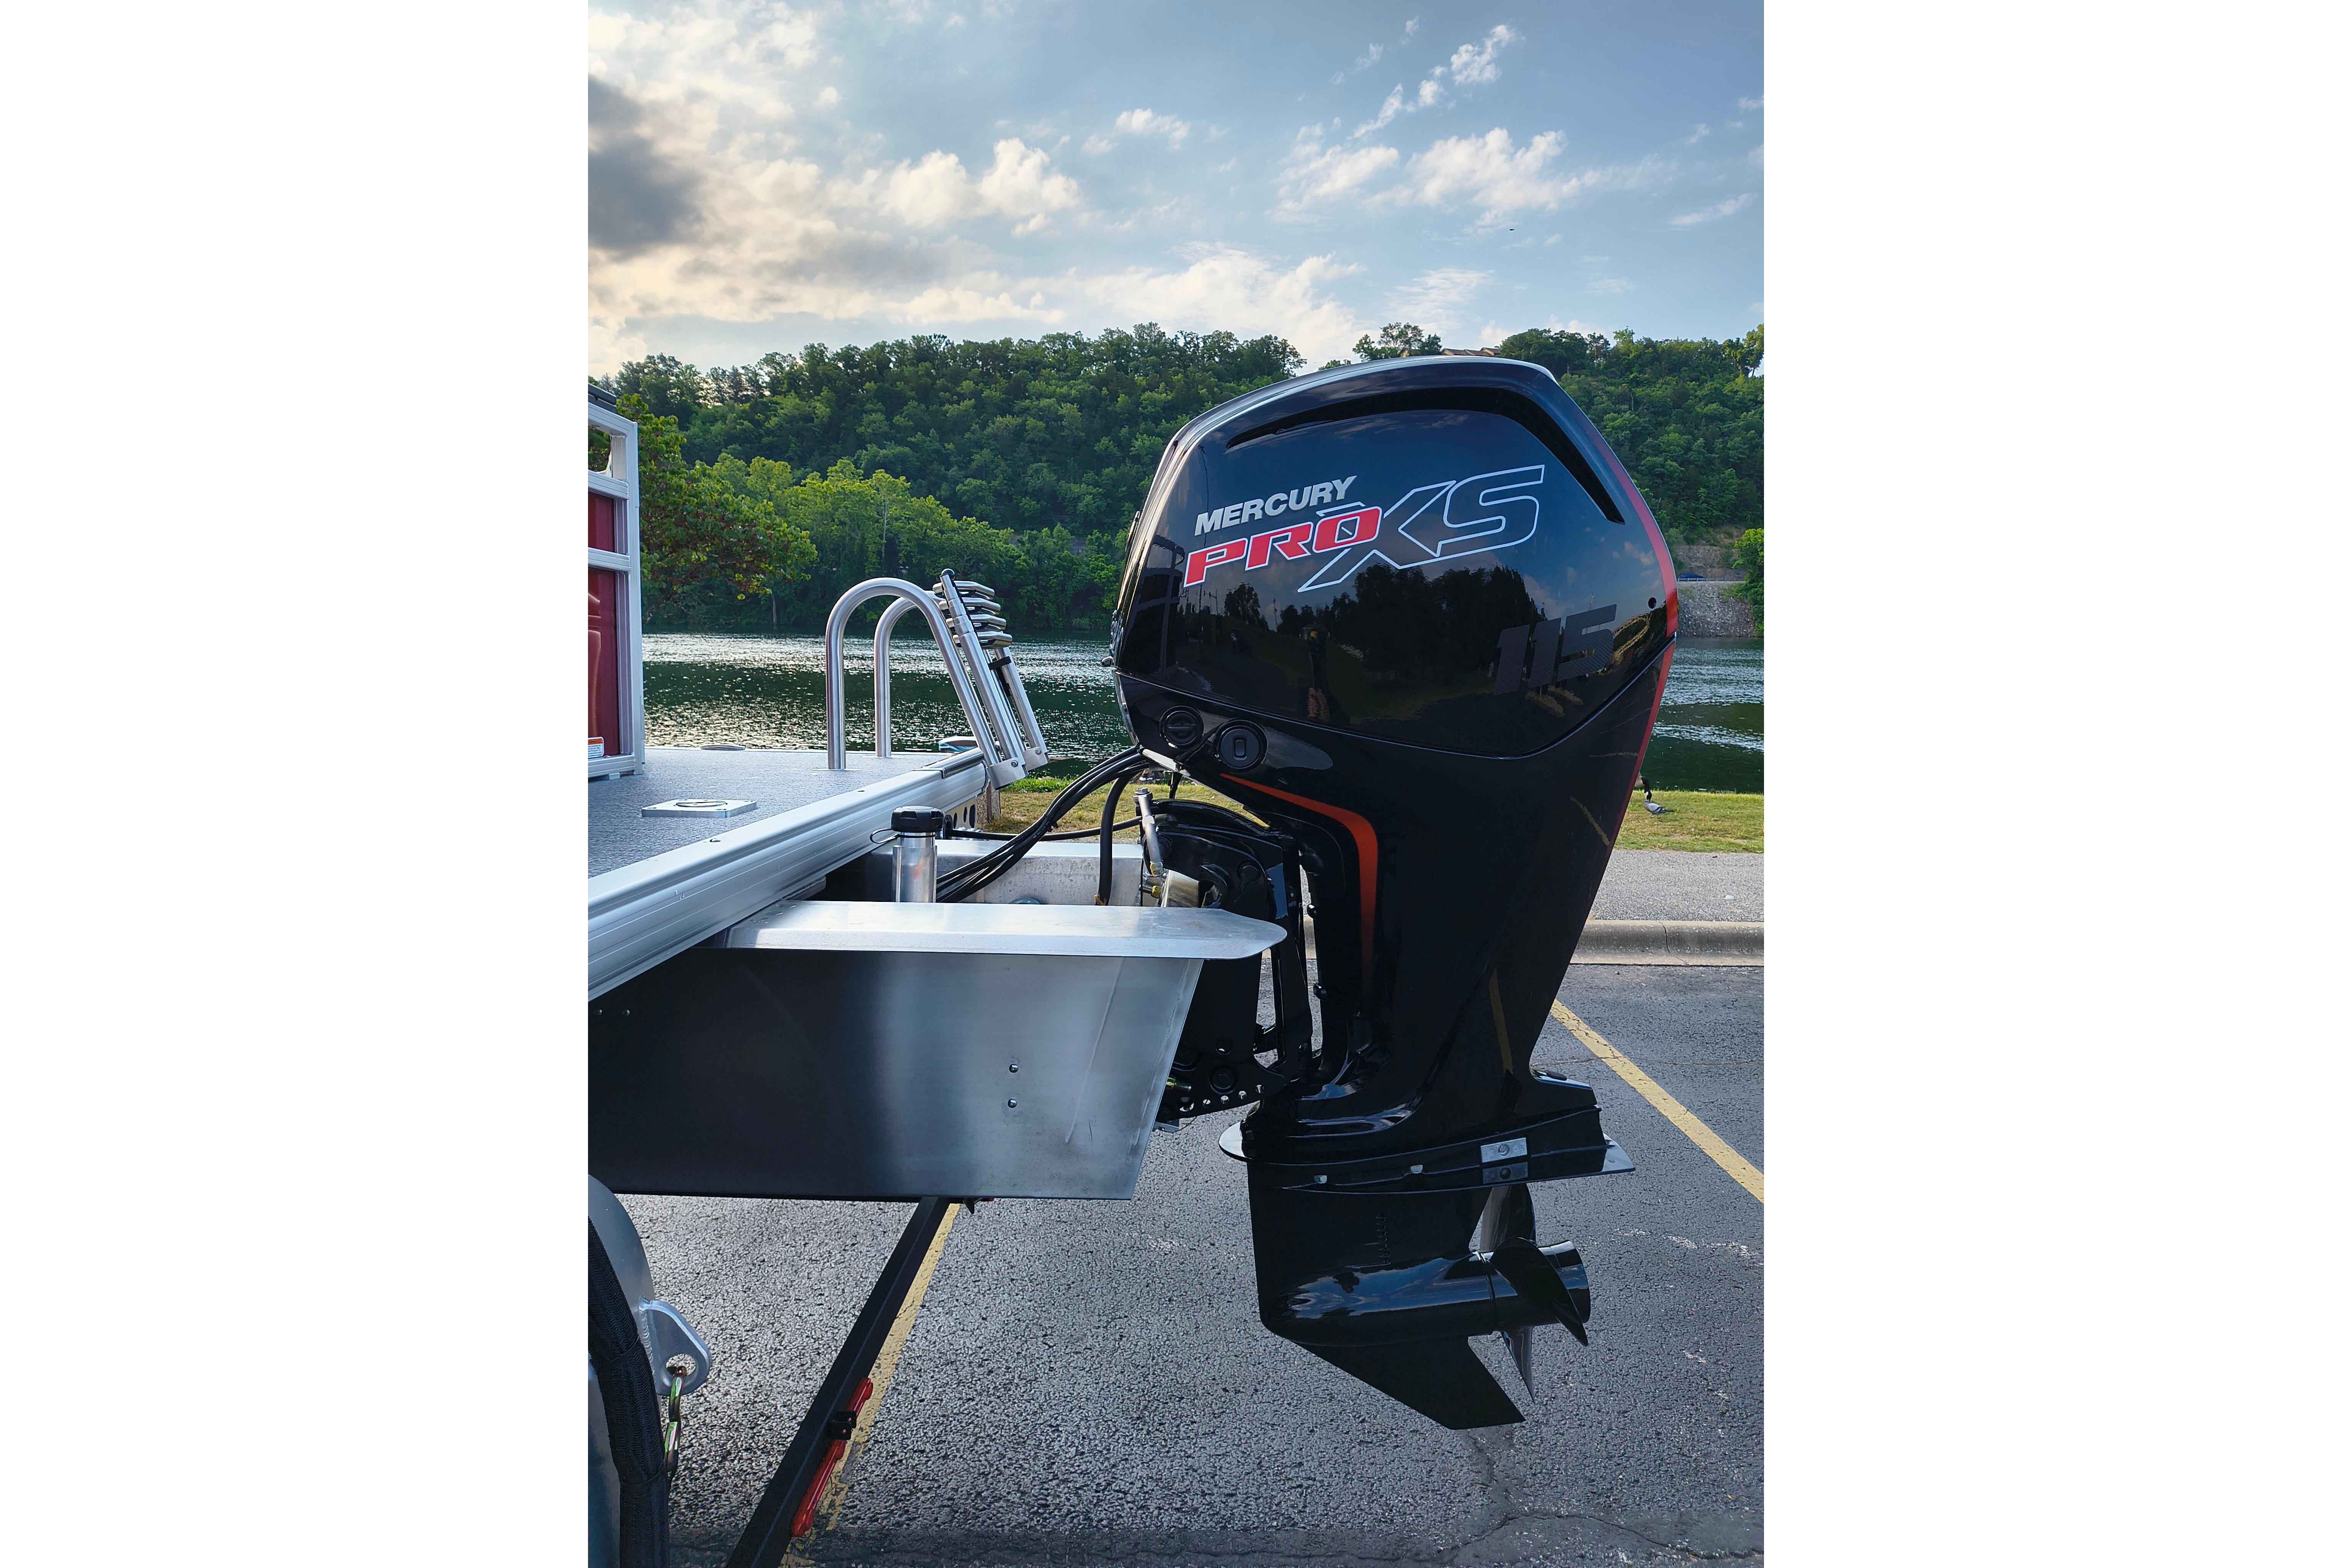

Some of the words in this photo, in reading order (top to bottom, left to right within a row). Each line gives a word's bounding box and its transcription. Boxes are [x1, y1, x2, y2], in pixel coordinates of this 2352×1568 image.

[1184, 506, 1382, 588] PRO
[1297, 464, 1545, 592] XS
[1194, 475, 1357, 536] MERCURY
[1494, 604, 1617, 695] 115
